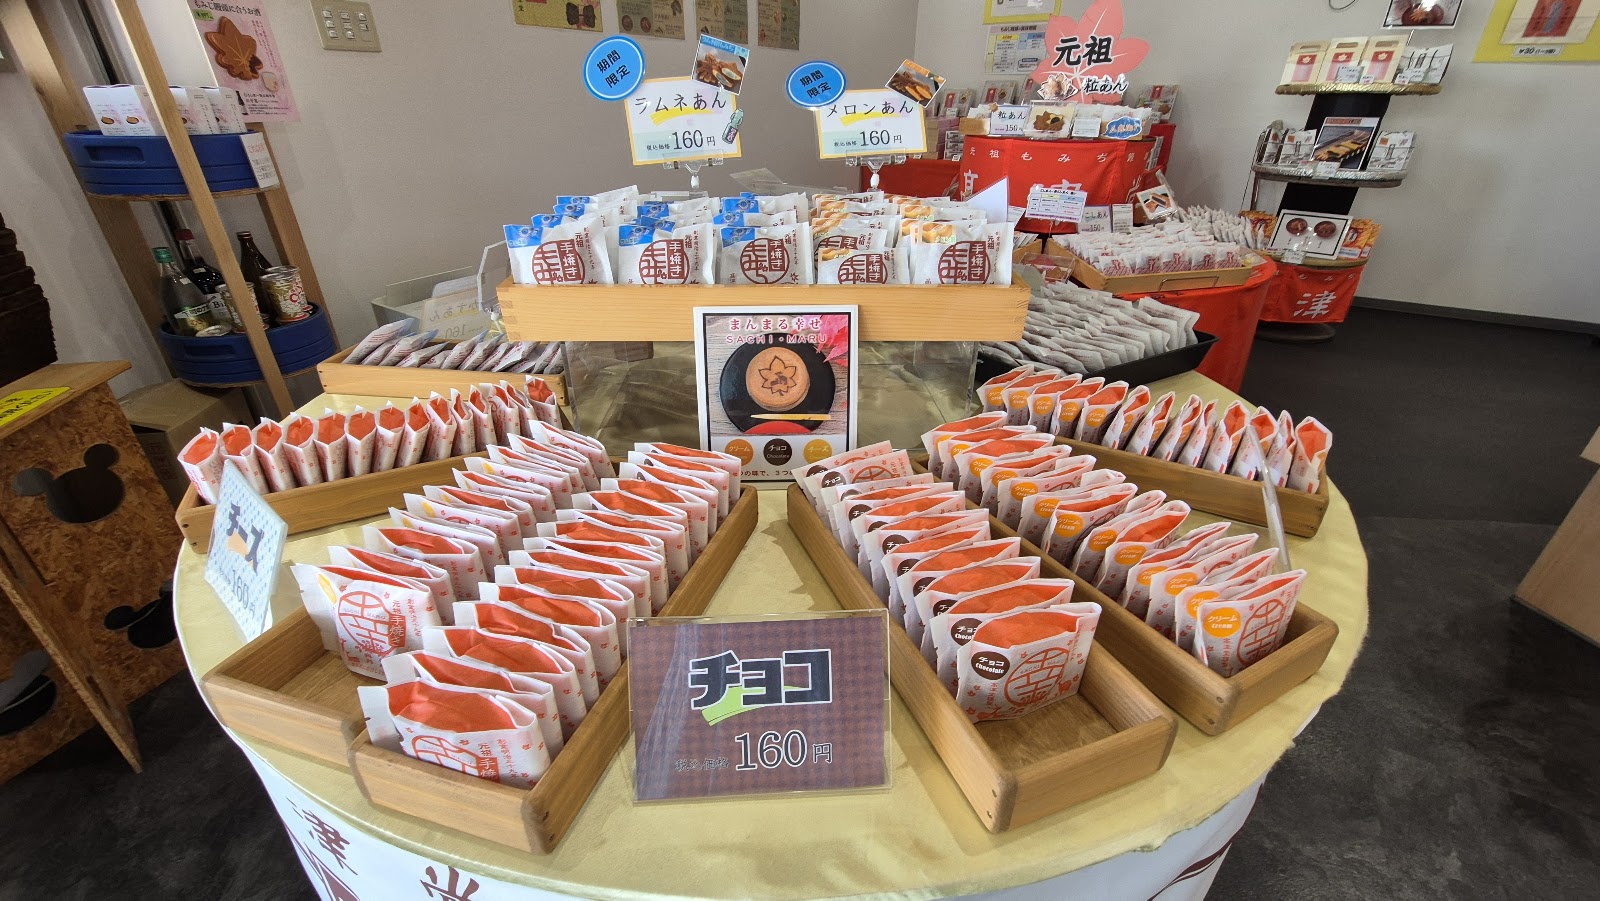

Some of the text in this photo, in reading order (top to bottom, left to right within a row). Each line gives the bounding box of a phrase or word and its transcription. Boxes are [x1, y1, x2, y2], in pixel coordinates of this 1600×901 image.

[1053, 35, 1113, 66] 元祖
[596, 49, 621, 73] 期間
[605, 64, 631, 88] 限定
[799, 69, 824, 88] 期間
[1084, 78, 1128, 93] 粒あん
[806, 81, 832, 99] 限定
[634, 92, 727, 114] ラムネあん
[827, 100, 914, 118] メロンあん
[998, 110, 1026, 119] 粒あん
[560, 242, 578, 280] 手焼き
[669, 241, 682, 277] 手焼き
[770, 240, 783, 271] 手焼き
[971, 243, 984, 279] 手焼き
[868, 254, 881, 282] 手焼き
[1293, 290, 1337, 319] 津
[730, 318, 822, 331] まんまる幸せ
[768, 444, 787, 452] チョコ
[808, 445, 829, 453] チーズ
[824, 476, 841, 486] チョコ
[1207, 614, 1238, 623] クリーム
[389, 617, 405, 647] 手焼き
[975, 662, 1005, 674] Chocolate
[978, 656, 1005, 667] チョコ
[688, 649, 832, 710] チョコ
[480, 758, 497, 777] 手焼
